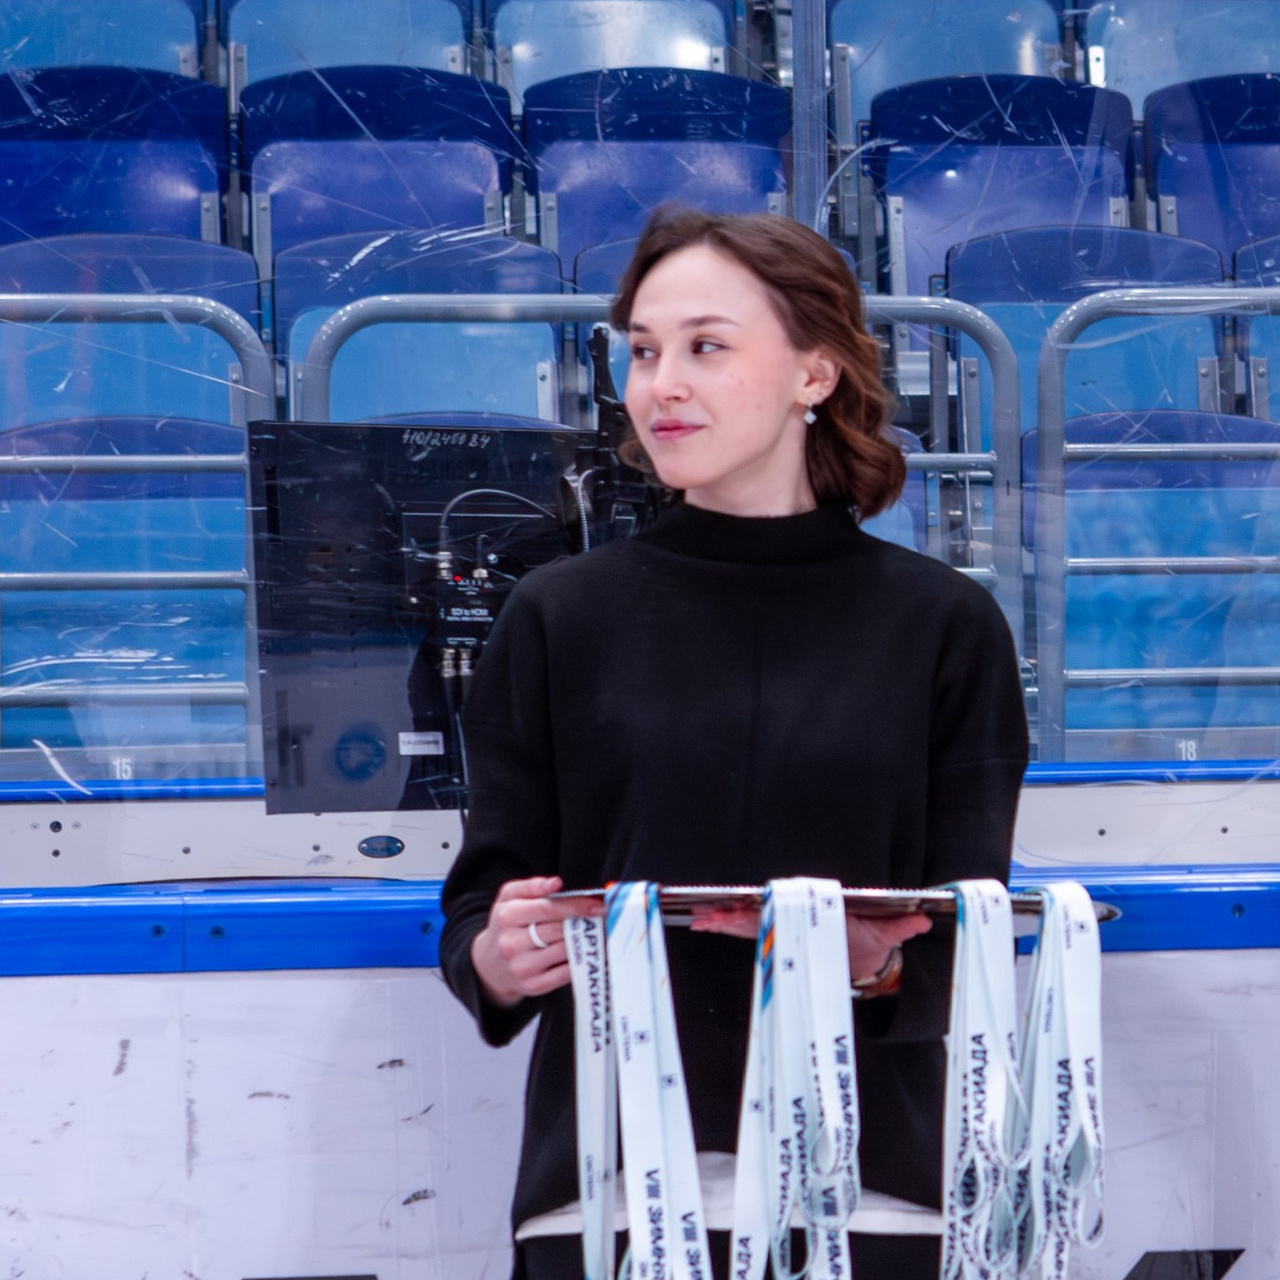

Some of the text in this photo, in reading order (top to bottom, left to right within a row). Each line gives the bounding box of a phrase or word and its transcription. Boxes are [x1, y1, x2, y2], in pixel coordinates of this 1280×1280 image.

[1178, 740, 1197, 761] 18
[112, 757, 132, 780] 15
[584, 918, 602, 1053] АРТАКИАДА
